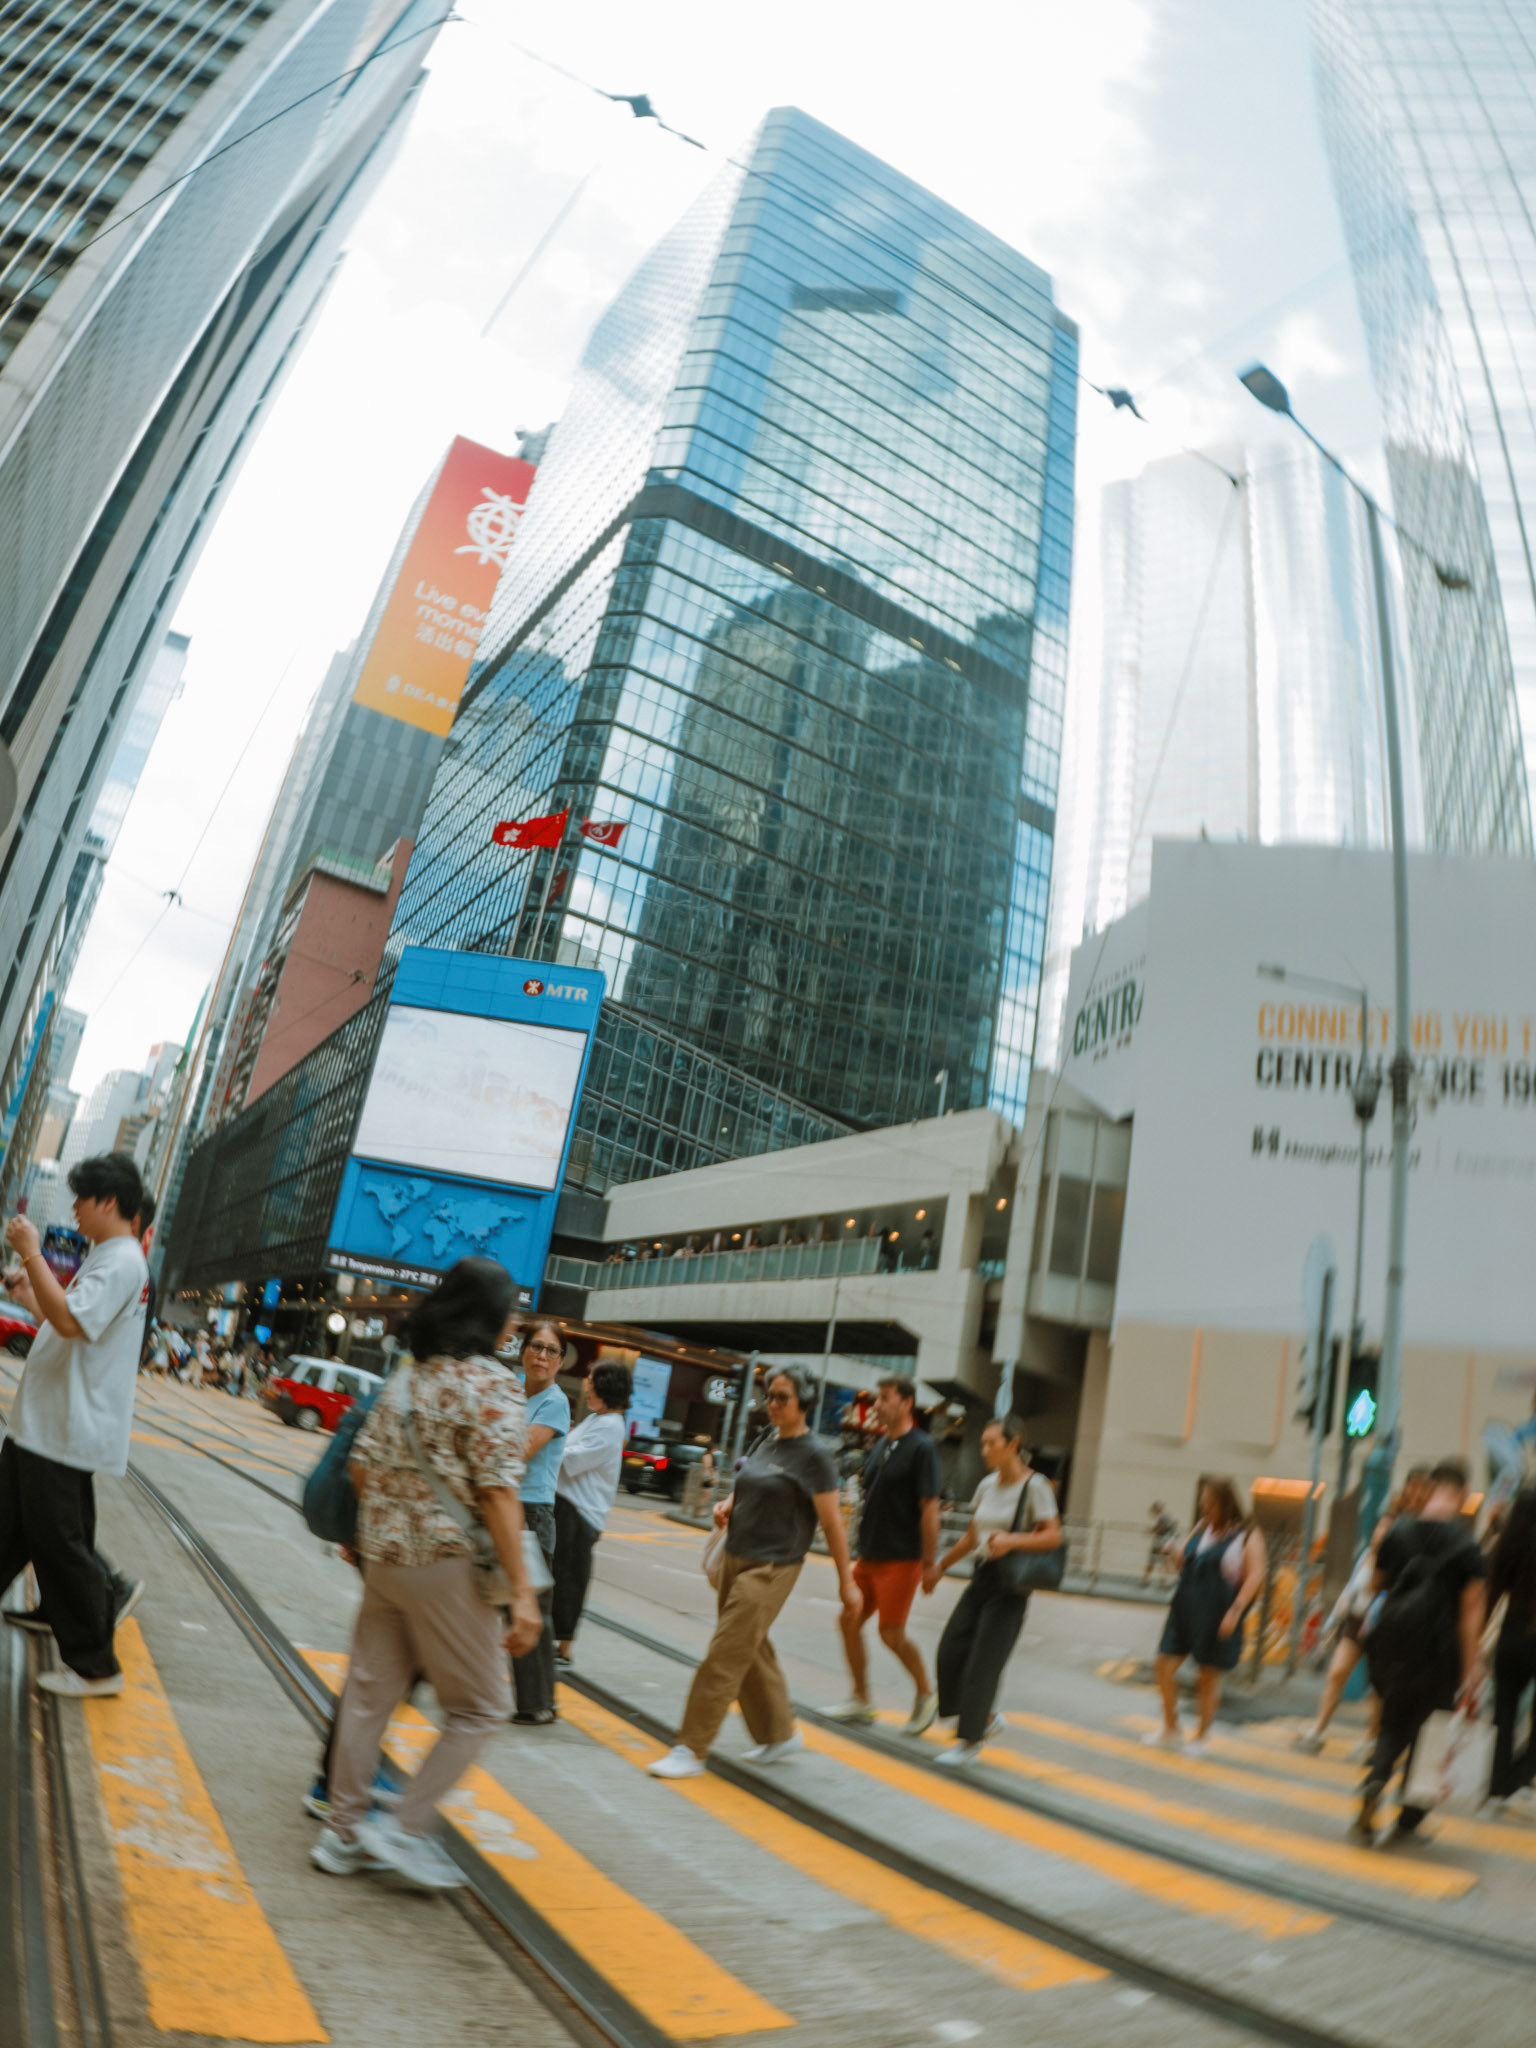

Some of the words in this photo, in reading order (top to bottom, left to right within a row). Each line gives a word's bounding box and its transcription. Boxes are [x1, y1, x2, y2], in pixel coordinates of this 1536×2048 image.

[415, 579, 457, 611] Live
[546, 983, 588, 1002] MTR
[1257, 1002, 1442, 1053] CONNECTNG
[1453, 1011, 1508, 1058] YOU
